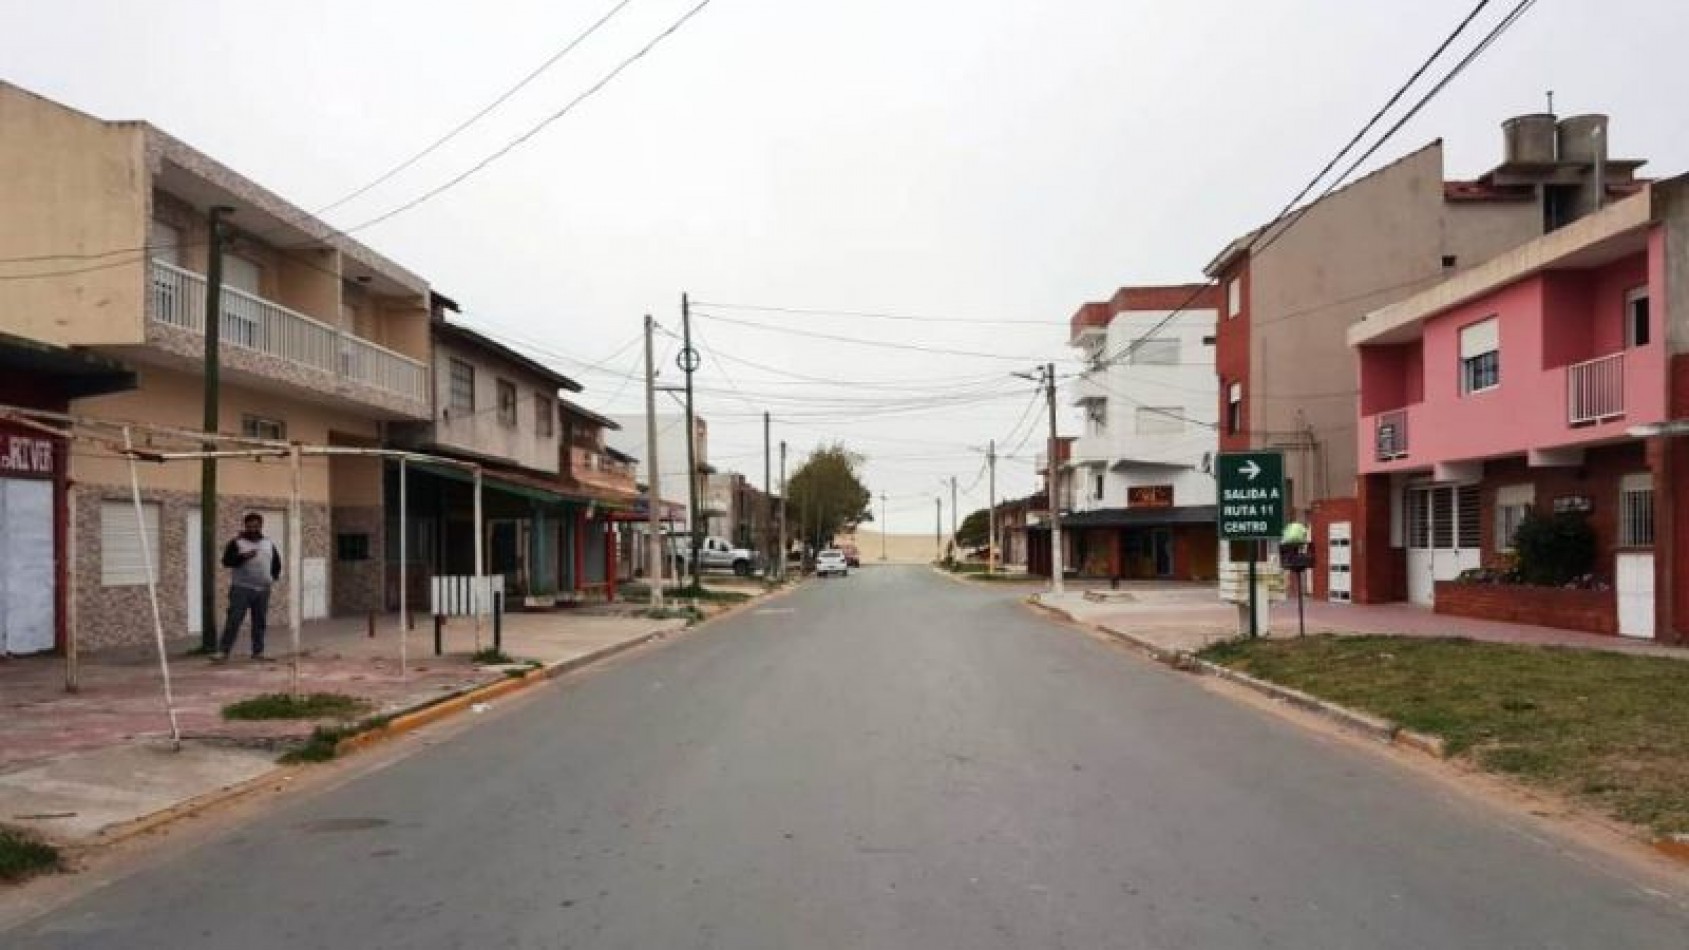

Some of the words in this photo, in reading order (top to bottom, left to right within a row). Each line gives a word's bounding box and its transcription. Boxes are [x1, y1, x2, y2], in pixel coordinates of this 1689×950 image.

[1224, 489, 1267, 499] SALIDA
[1270, 488, 1280, 499] A
[1224, 505, 1257, 516] RUTA
[1261, 504, 1274, 516] 11
[1224, 521, 1268, 533] CENTRO
